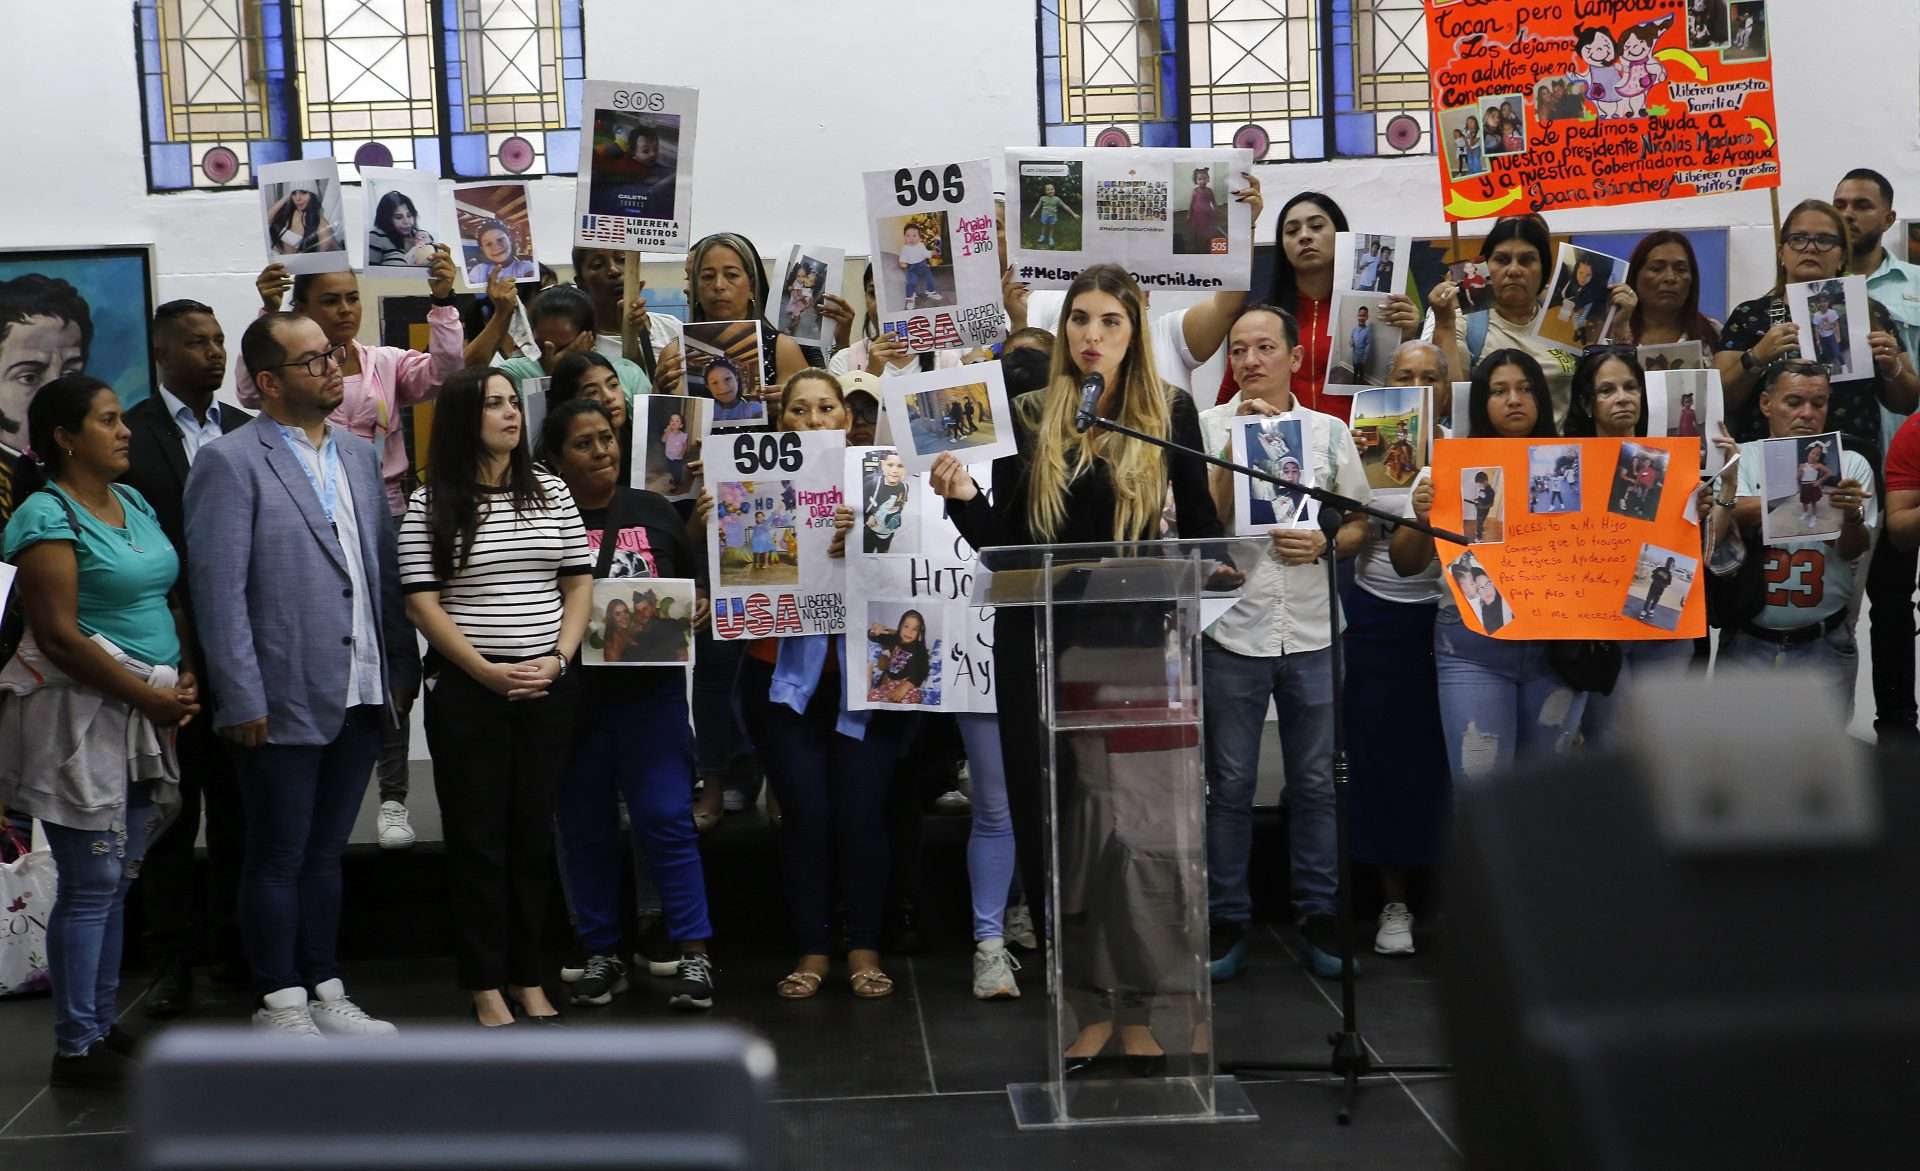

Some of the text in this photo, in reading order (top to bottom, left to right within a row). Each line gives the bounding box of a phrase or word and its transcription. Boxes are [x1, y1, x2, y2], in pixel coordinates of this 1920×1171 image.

[1516, 6, 1562, 35] pero
[1461, 35, 1500, 59] Los
[1472, 59, 1526, 83] adultos
[1530, 62, 1554, 82] que
[1557, 61, 1577, 74] no
[1727, 79, 1768, 91] nuestra
[613, 90, 665, 111] SOS
[1530, 113, 1726, 146] Le pedimos ayuda a
[1490, 149, 1555, 172] nuestro
[1561, 137, 1638, 165] presidente
[1697, 129, 1754, 152] Maduro
[1480, 149, 1774, 198] y a nuestra Gobernadora de Aragua
[1728, 169, 1736, 177] a
[894, 164, 965, 207] SOS
[581, 215, 625, 243] USA
[627, 219, 669, 228] LIBEREN
[627, 228, 678, 238] NUESTROS
[637, 238, 666, 246] HIJOS
[962, 245, 971, 256] 1
[956, 303, 999, 323] LIBEREN
[971, 327, 998, 344] HIJOS
[733, 432, 803, 474] SOS
[799, 486, 843, 505] Hannah
[805, 518, 812, 528] 4
[1764, 548, 1825, 608] 23
[798, 593, 842, 608] LIBEREN
[715, 593, 803, 638] USA
